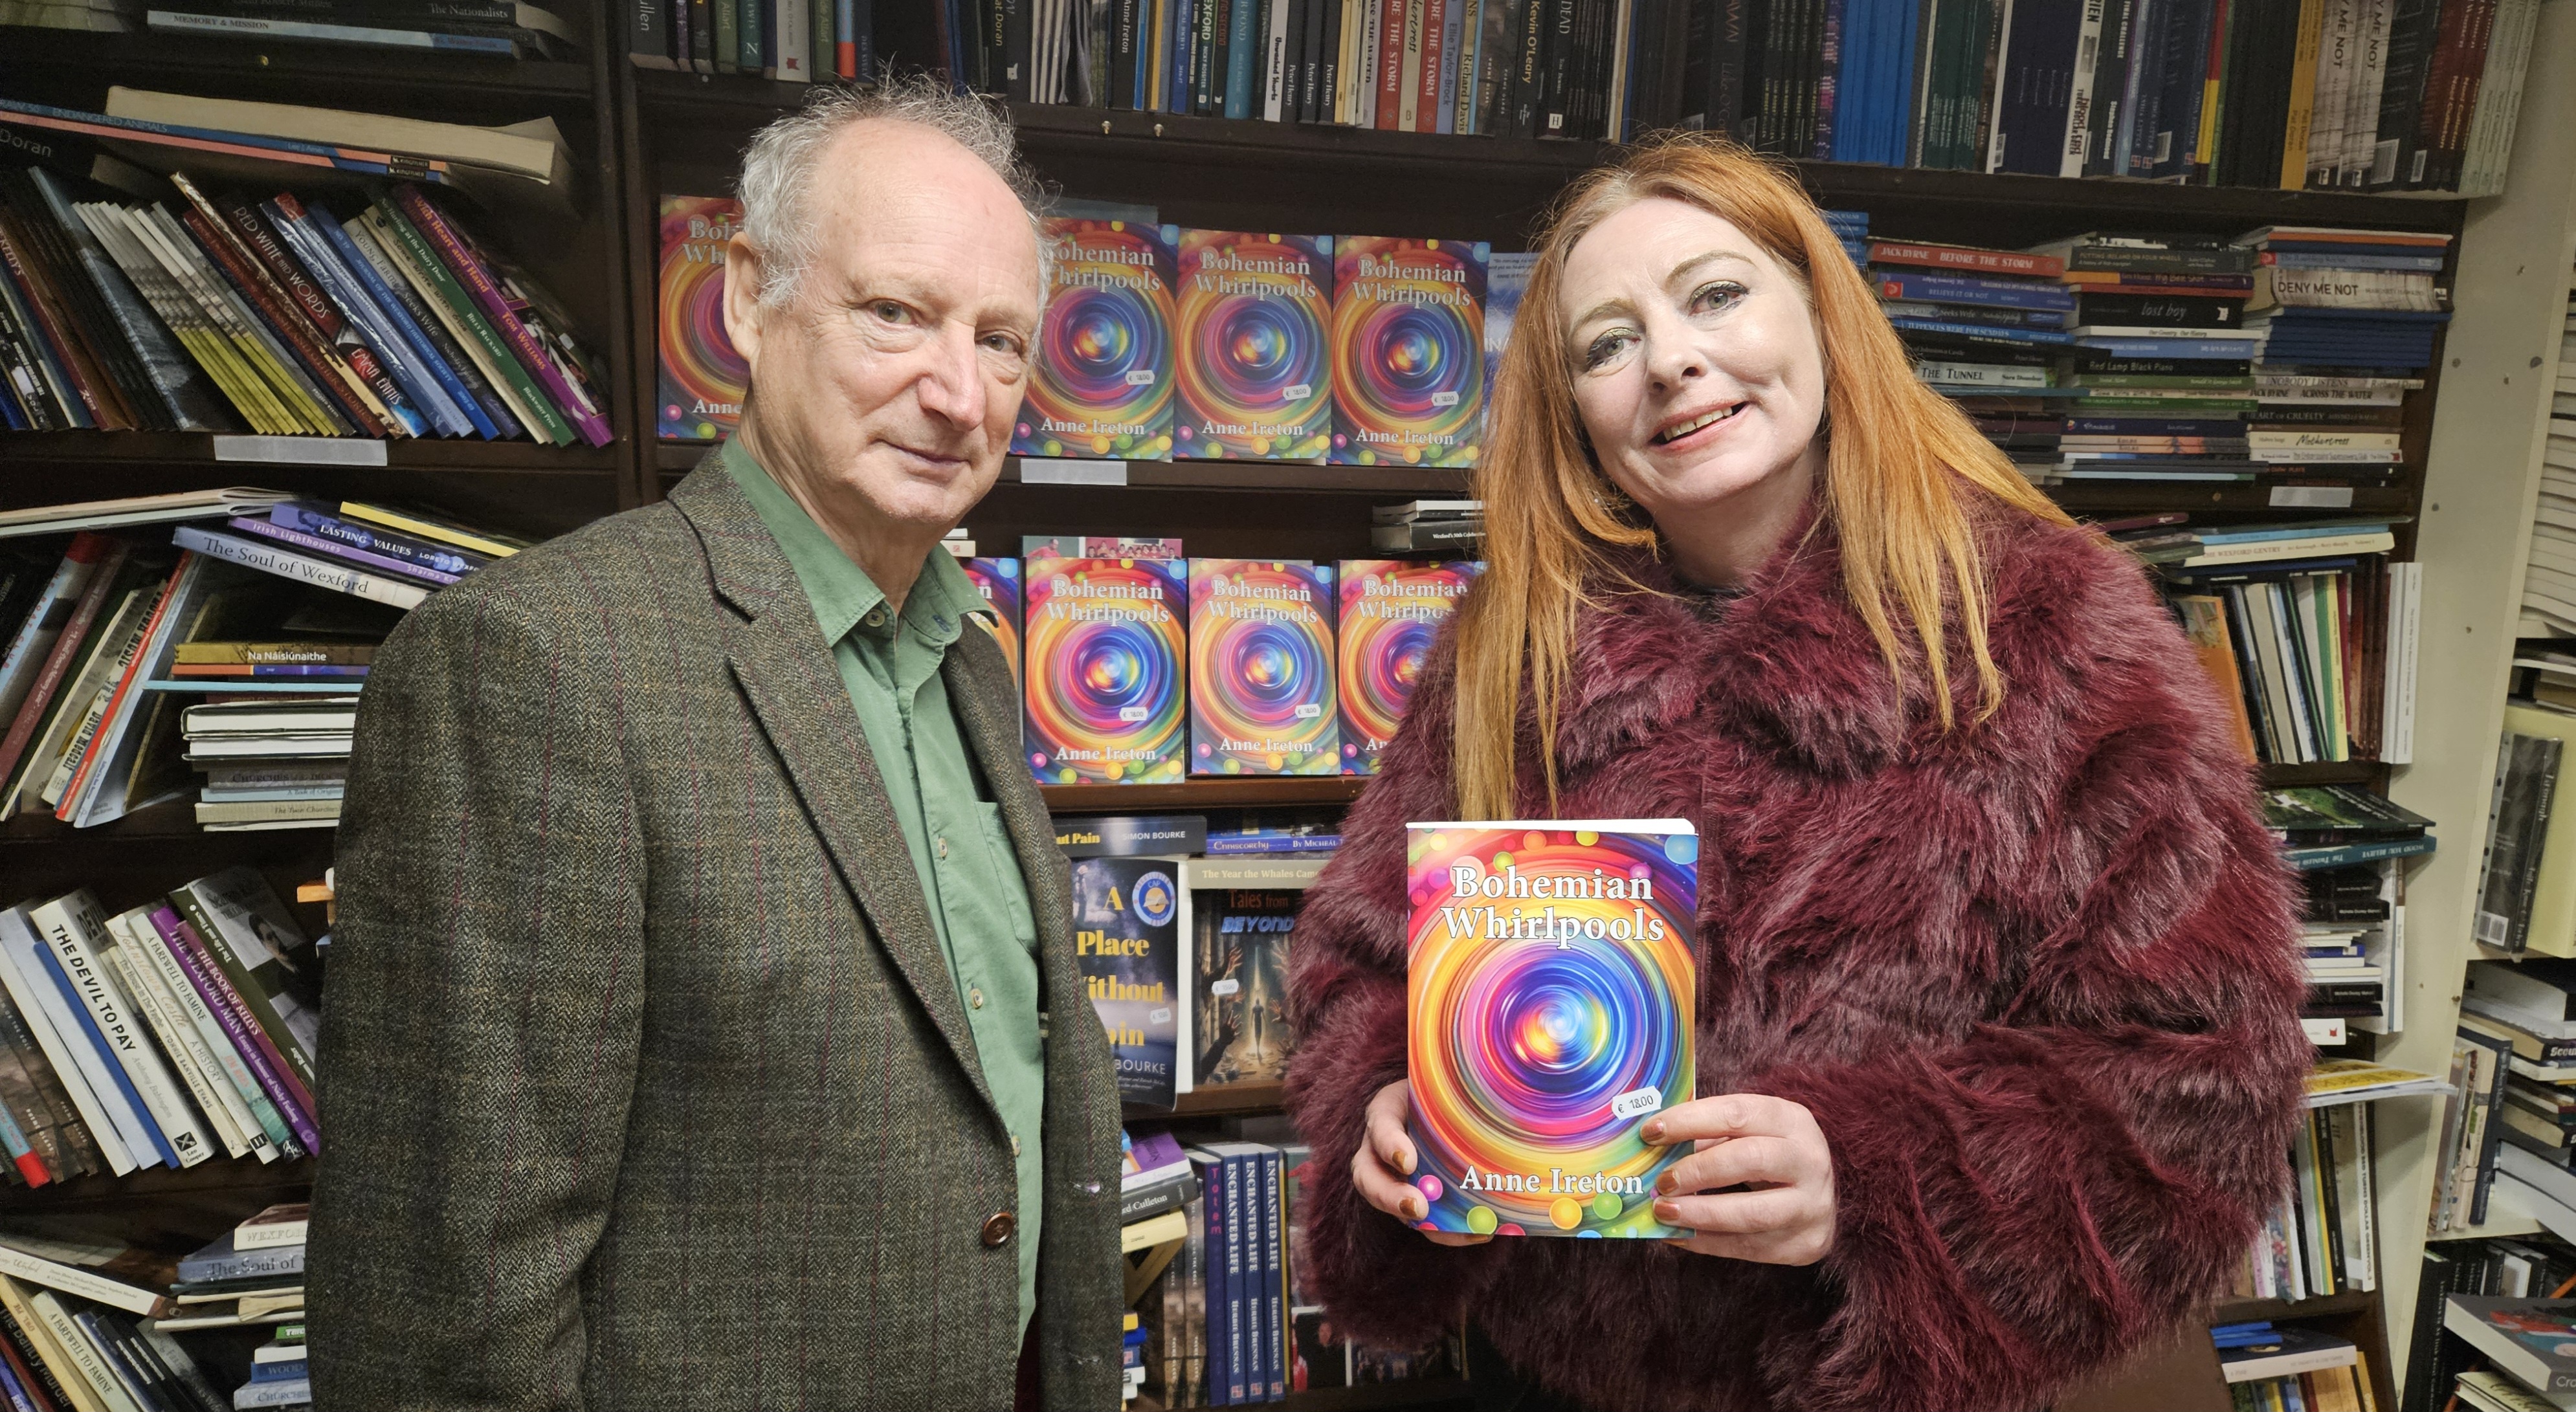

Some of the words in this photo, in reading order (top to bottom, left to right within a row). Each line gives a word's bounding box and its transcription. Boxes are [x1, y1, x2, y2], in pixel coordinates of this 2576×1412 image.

[173, 15, 218, 27] MEMORY
[230, 19, 269, 30] MISSION
[427, 3, 447, 14] The
[449, 5, 508, 19] Nationalists
[1122, 0, 1132, 27] Anne
[1529, 1, 1540, 34] Kevin
[1559, 1, 1571, 34] DEAD
[995, 17, 1003, 47] Doran
[1391, 21, 1399, 47] THE
[1449, 23, 1457, 48] Ellie
[2336, 16, 2346, 36] ME
[2371, 13, 2383, 36] ME
[1121, 28, 1131, 54] Ireton
[1428, 26, 1439, 50] THE
[1272, 37, 1283, 74] Unwashed
[1522, 37, 1537, 83] O'Leary
[2334, 36, 2346, 70] NOT
[2368, 39, 2379, 72] NOT
[1307, 63, 1315, 84] Peter
[1387, 51, 1398, 92] STORM
[1425, 56, 1436, 96] STORM
[1443, 50, 1456, 106] Taylor-Brock
[1461, 54, 1474, 94] Richard
[1271, 77, 1280, 101] Shorts
[1305, 83, 1313, 105] Henry
[52, 107, 122, 126] ENDANGERED
[126, 118, 168, 133] ANIMALS
[1458, 98, 1469, 131] Davis
[233, 206, 258, 233] RED
[256, 230, 278, 261] WINE
[289, 273, 333, 319] WORDS
[1201, 252, 1310, 275] Bohemian
[1360, 259, 1466, 283] Bohemian
[1881, 247, 1902, 258] JACK
[1940, 252, 1975, 264] BEFORE
[1979, 254, 1998, 266] THE
[2001, 256, 2033, 269] STORM
[414, 195, 434, 221] With
[432, 219, 454, 248] Heart
[452, 247, 469, 267] and
[467, 265, 489, 293] Hand
[501, 311, 518, 333] TOM
[516, 329, 546, 371] WILLIAMS
[1058, 265, 1161, 293] hirlpools
[1194, 274, 1316, 301] Whirlpools
[2278, 281, 2311, 292] DENY
[2313, 283, 2331, 294] ME
[2335, 284, 2359, 295] NOT
[1352, 282, 1471, 309] Whirlpools
[2141, 302, 2162, 316] lost
[2165, 303, 2186, 320] boy
[419, 248, 434, 270] Dairy
[432, 265, 446, 283] Door
[523, 387, 548, 417] Blackwater
[421, 316, 439, 338] Wife
[351, 349, 381, 377] EMMA
[375, 375, 401, 405] ENNIS
[1921, 367, 1940, 378] THE
[1948, 369, 1984, 381] TUNNEL
[2269, 377, 2309, 386] NOBODY
[2300, 390, 2329, 399] ACROSS
[2331, 390, 2346, 399] THE
[2348, 390, 2373, 400] WATER
[1041, 417, 1086, 434] Anne
[1093, 419, 1146, 435] Ireton
[1201, 421, 1247, 436] Anne
[1251, 422, 1304, 436] Ireton
[2286, 412, 2325, 420] CRUELTY
[1355, 428, 1399, 443] Anne
[1404, 430, 1454, 445] Ireton
[252, 523, 277, 538] Irish
[280, 530, 341, 553] Lighthouses
[320, 524, 366, 543] LASTING
[374, 539, 412, 556] VALUES
[204, 537, 234, 557] The
[238, 547, 276, 568] Soul
[278, 557, 297, 573] of
[302, 564, 368, 594] Wexford
[1052, 580, 1164, 600] Bohemian
[1212, 579, 1311, 602] Bohemian
[1045, 602, 1170, 626] Whirlpools
[1207, 600, 1318, 625] Whirlpools
[248, 652, 262, 660] Na
[264, 651, 326, 661] Náisiúnaithe
[1056, 747, 1100, 760] Anne
[1105, 747, 1157, 760] Ireton
[1219, 738, 1261, 751] Anne
[1265, 738, 1313, 752] Ireton
[1072, 833, 1100, 844] Pain
[1123, 832, 1150, 841] SIMON
[1219, 870, 1242, 879] Year
[1261, 870, 1294, 878] Whales
[1450, 865, 1654, 901] Bohemian
[1104, 886, 1124, 910] A
[1265, 894, 1288, 907] from
[1439, 905, 1665, 951] Whirlpools
[1076, 931, 1149, 956] Place
[51, 923, 77, 957] THE
[69, 954, 104, 1004] DEVIL
[97, 1002, 117, 1031] TO
[113, 1024, 137, 1053] PAY
[152, 942, 179, 980] FAREWELL
[176, 979, 188, 994] TO
[185, 990, 208, 1022] FAMINE
[197, 949, 212, 969] THE
[210, 967, 230, 995] BOOK
[227, 991, 239, 1006] OF
[236, 1000, 260, 1036] KELLY'S
[1084, 975, 1163, 1002] ithout
[220, 1004, 245, 1035] MAN
[161, 995, 190, 1029] Castle
[195, 1046, 224, 1083] HISTORY
[1115, 1059, 1166, 1074] BOURKE
[1617, 1103, 1624, 1114] €
[1459, 1165, 1541, 1193] Anne
[1549, 1168, 1644, 1195] Ireton
[1133, 1195, 1168, 1211] Culleton
[1227, 1163, 1238, 1244] ENCHANTED
[1247, 1161, 1258, 1242] ENCHANTED
[1267, 1159, 1278, 1241] ENCHANTED
[209, 1262, 238, 1276] The
[241, 1259, 275, 1274] Soul
[278, 1255, 296, 1270] of
[1230, 1245, 1239, 1275] LIFE
[1249, 1243, 1258, 1272] LIFE
[1269, 1242, 1278, 1270] LIFE
[54, 1319, 84, 1358] FAREWELL
[82, 1357, 94, 1372] TO
[91, 1366, 114, 1396] FAMINE
[268, 1364, 304, 1375] WOOD
